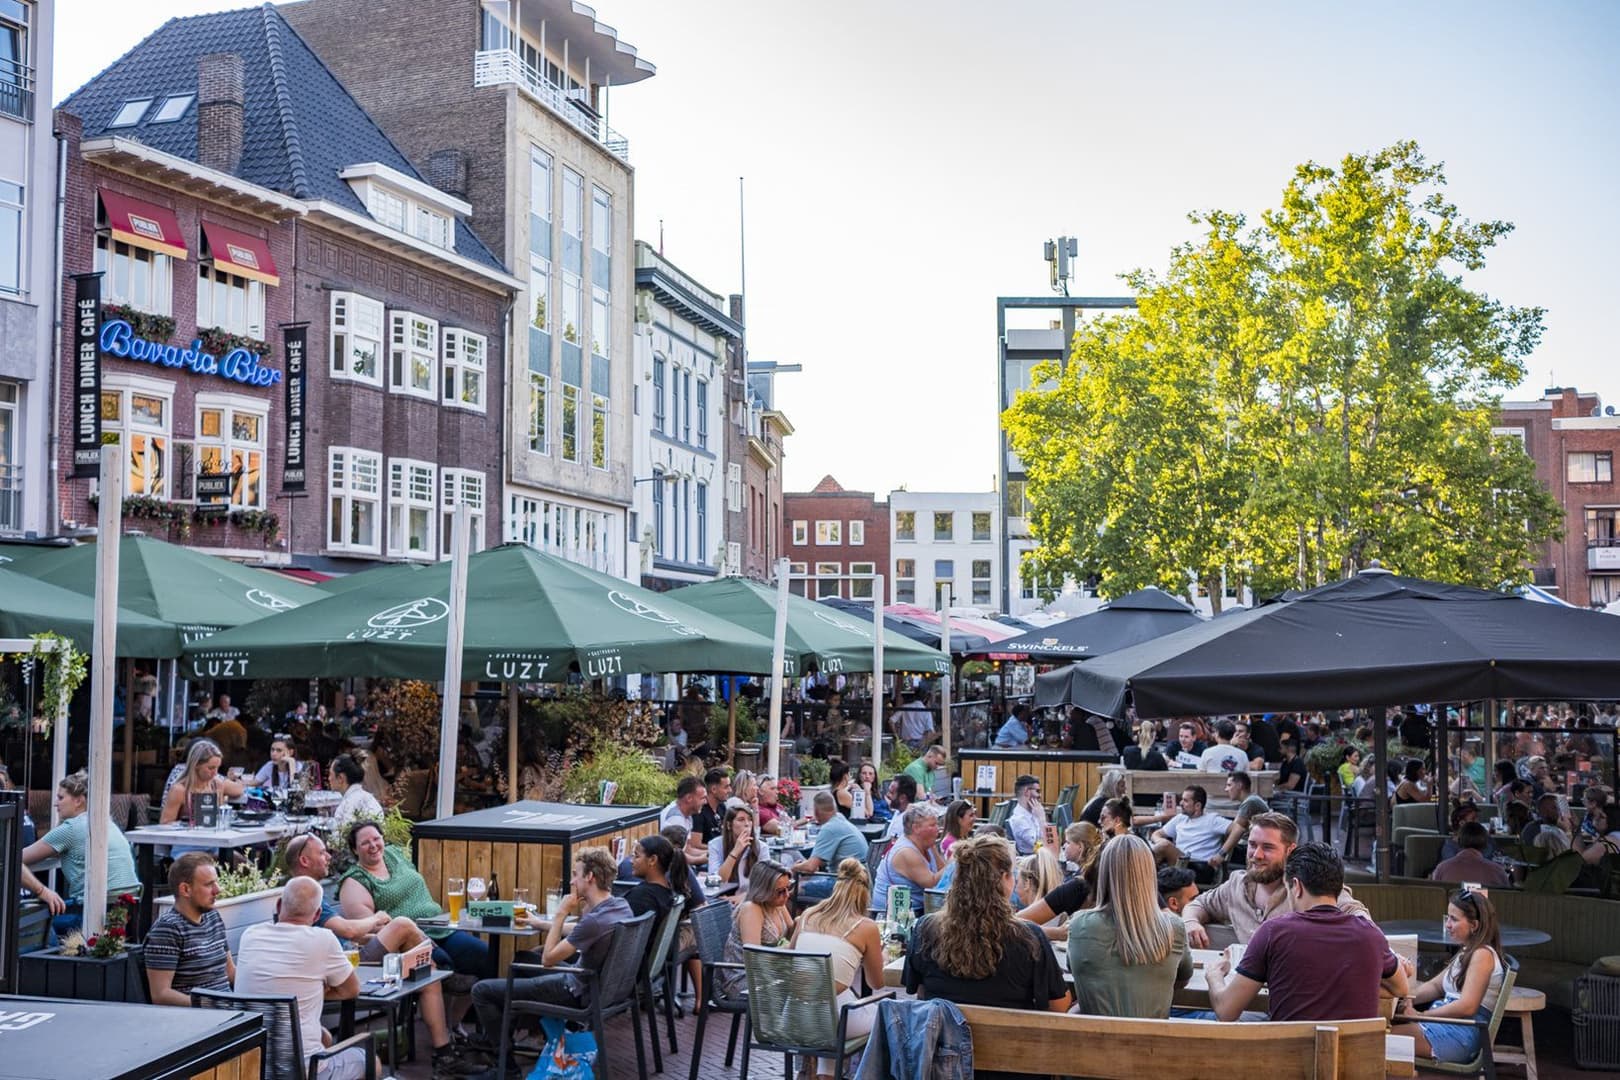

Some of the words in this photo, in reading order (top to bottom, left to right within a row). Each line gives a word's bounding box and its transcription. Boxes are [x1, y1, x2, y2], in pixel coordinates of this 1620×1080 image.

[78, 299, 95, 336] CAFÉ
[80, 342, 95, 388] DINER
[100, 319, 217, 374] Bavaria
[219, 346, 282, 387] Bier
[287, 340, 302, 373] CAFÉ
[290, 377, 301, 417] DINER
[80, 393, 95, 443] LUNCH
[288, 421, 301, 463] LUNCH
[193, 660, 249, 676] LUZT
[486, 661, 549, 679] LUZT
[589, 656, 622, 676] LUZT
[822, 658, 843, 673] LUZT
